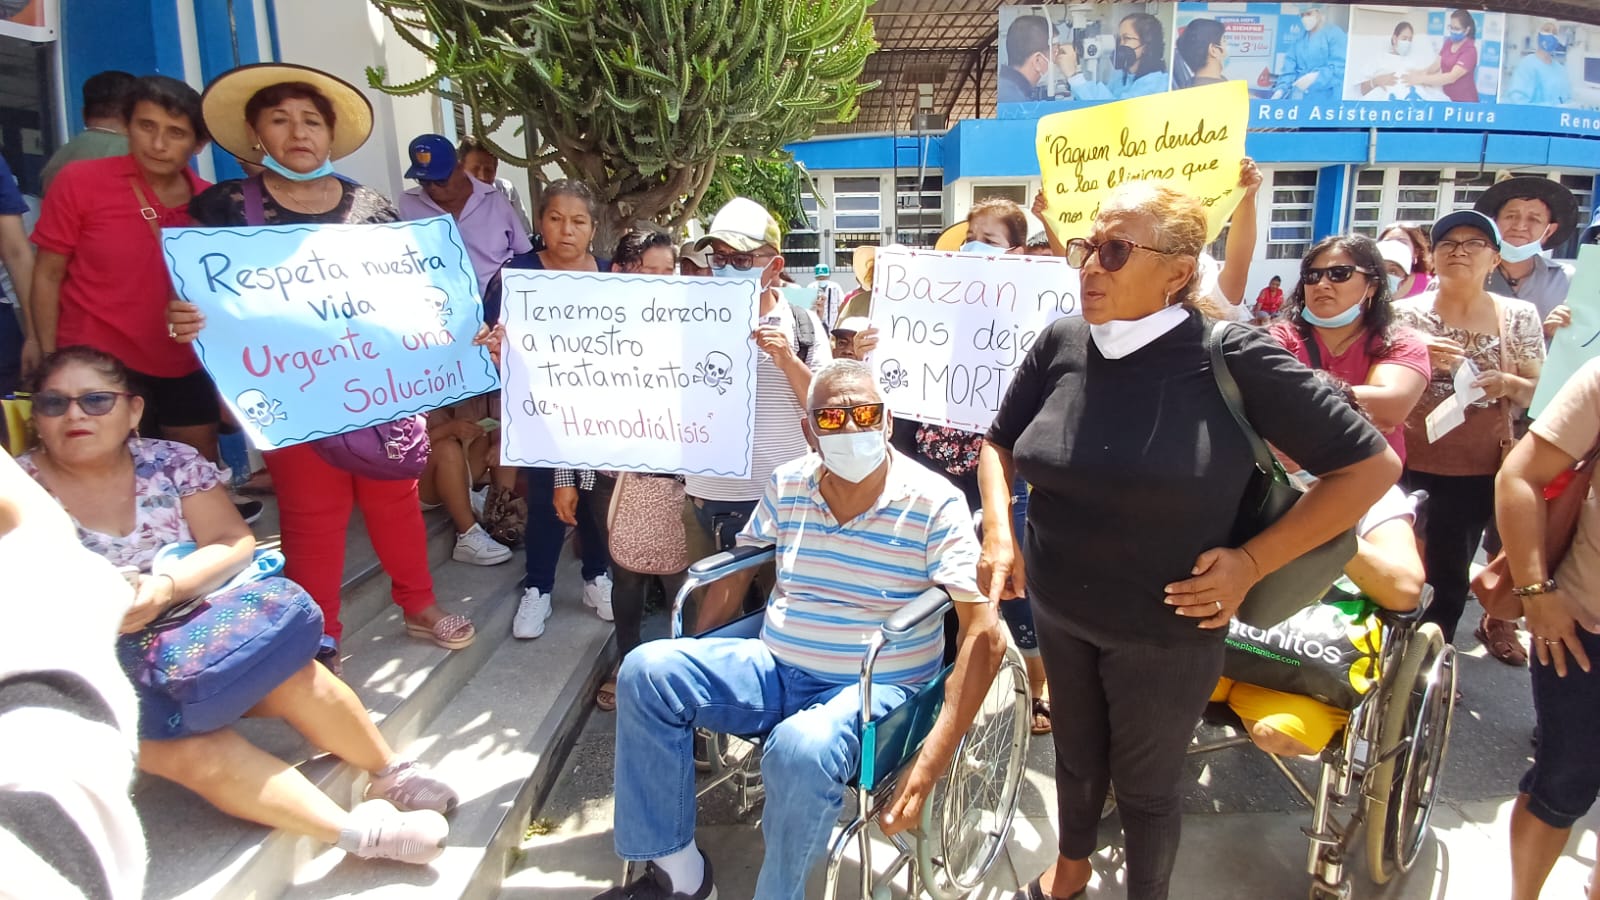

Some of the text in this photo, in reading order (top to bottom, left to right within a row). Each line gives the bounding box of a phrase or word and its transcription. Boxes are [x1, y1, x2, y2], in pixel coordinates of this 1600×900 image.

[1258, 104, 1496, 123] Red Asistencial Piura
[1118, 127, 1148, 157] las
[1154, 118, 1229, 152] deudas
[1056, 180, 1069, 194] a
[1074, 176, 1099, 193] las
[1182, 158, 1219, 182] que
[1059, 209, 1083, 224] nos
[199, 244, 446, 301] Respeta nuestra
[885, 264, 1076, 314] Bazan no
[307, 291, 376, 322] vida
[515, 290, 732, 324] Tenemos derecho
[521, 325, 643, 357] a nuestro
[891, 314, 949, 346] nos
[242, 327, 457, 392] Urgente una
[537, 358, 691, 388] tratamiento
[343, 359, 467, 413] Solución!
[922, 363, 1020, 412] MORI
[522, 392, 553, 416] de
